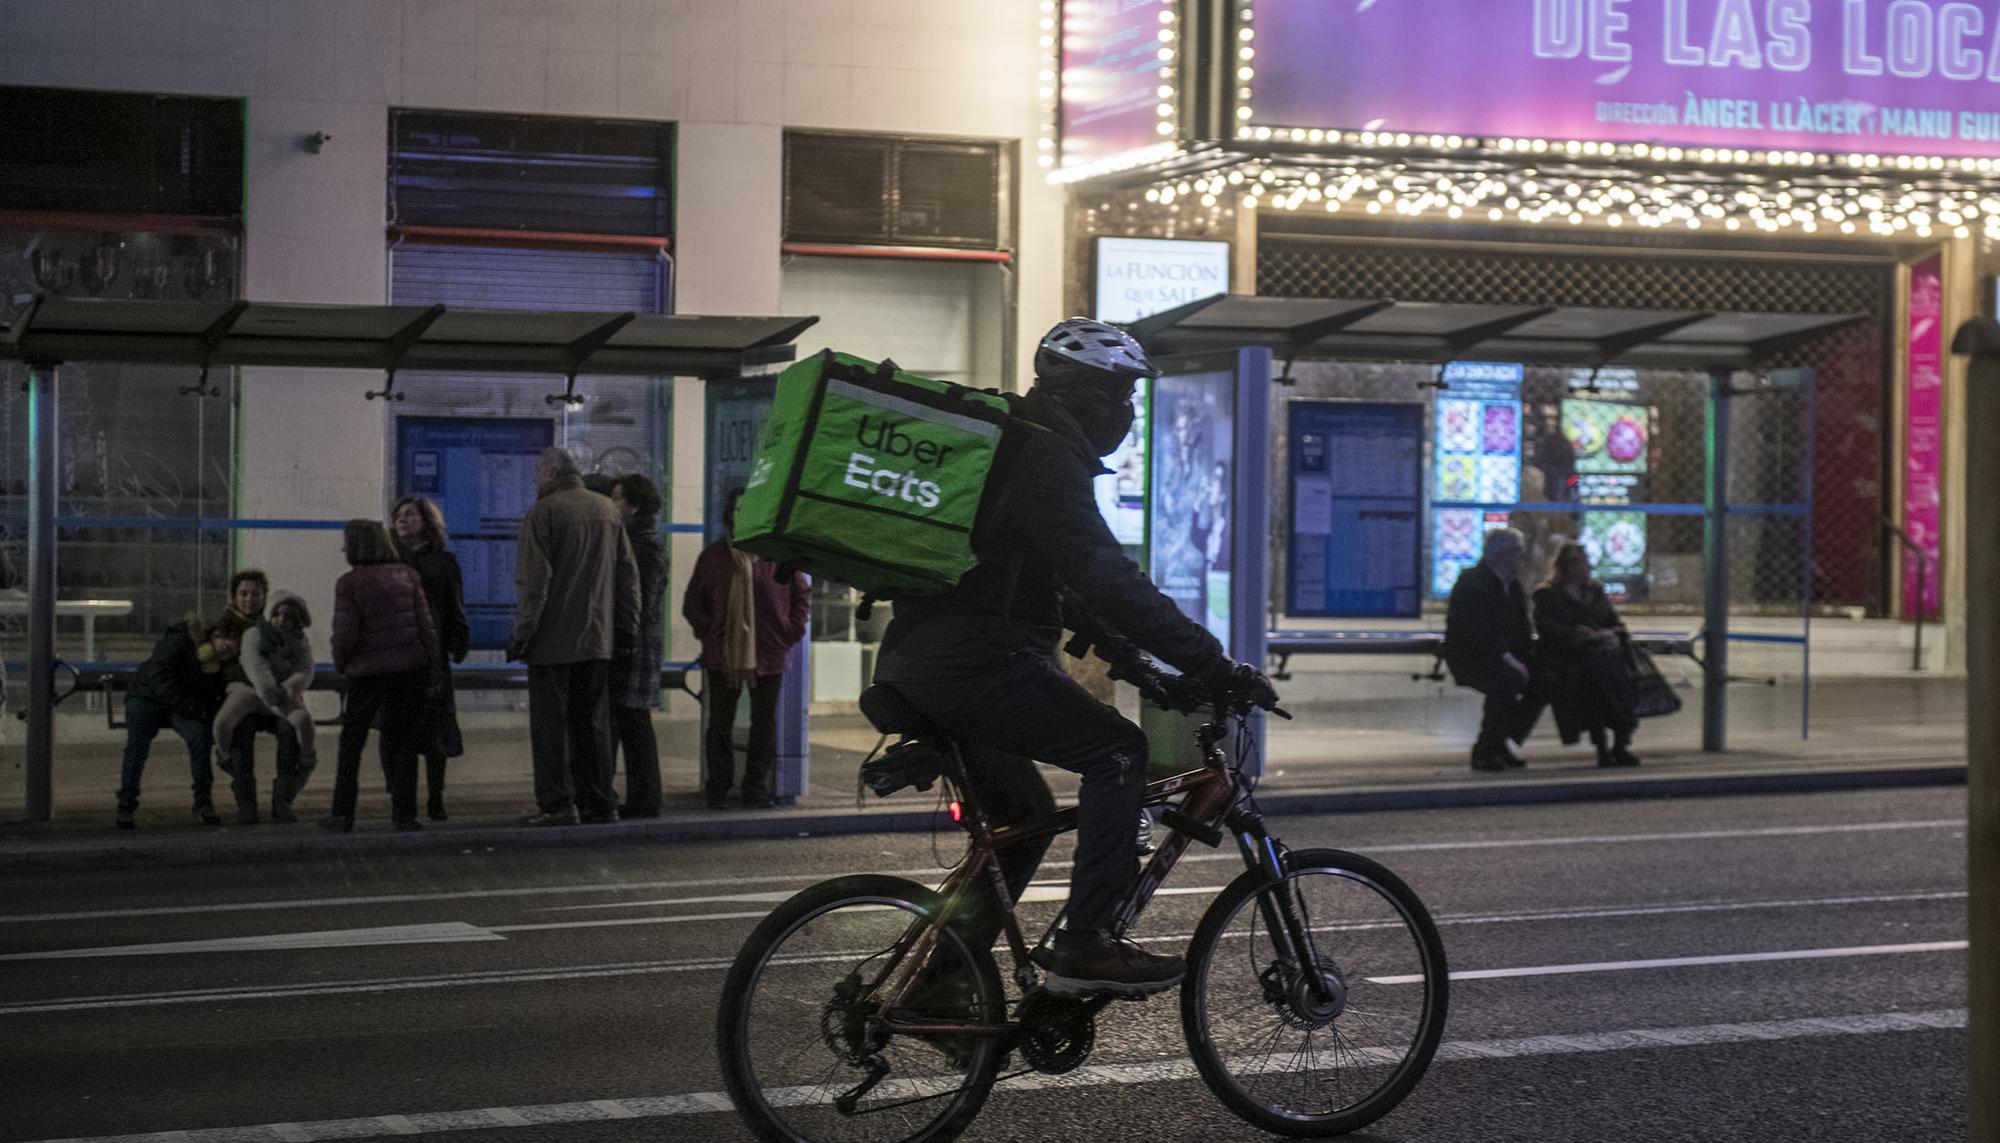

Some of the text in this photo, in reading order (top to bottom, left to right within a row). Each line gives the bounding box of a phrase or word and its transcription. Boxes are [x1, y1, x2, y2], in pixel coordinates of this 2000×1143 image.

[1533, 0, 2000, 83] DE LAS LOC
[1595, 100, 1679, 126] DIRECCIÓN
[1683, 90, 1764, 131] ÀNGEL
[1770, 96, 1861, 136] LLÀCER
[1880, 107, 1953, 140] MANU
[1127, 262, 1219, 282] FUNCIÓN
[857, 415, 954, 469] Uber
[843, 452, 941, 509] Eats
